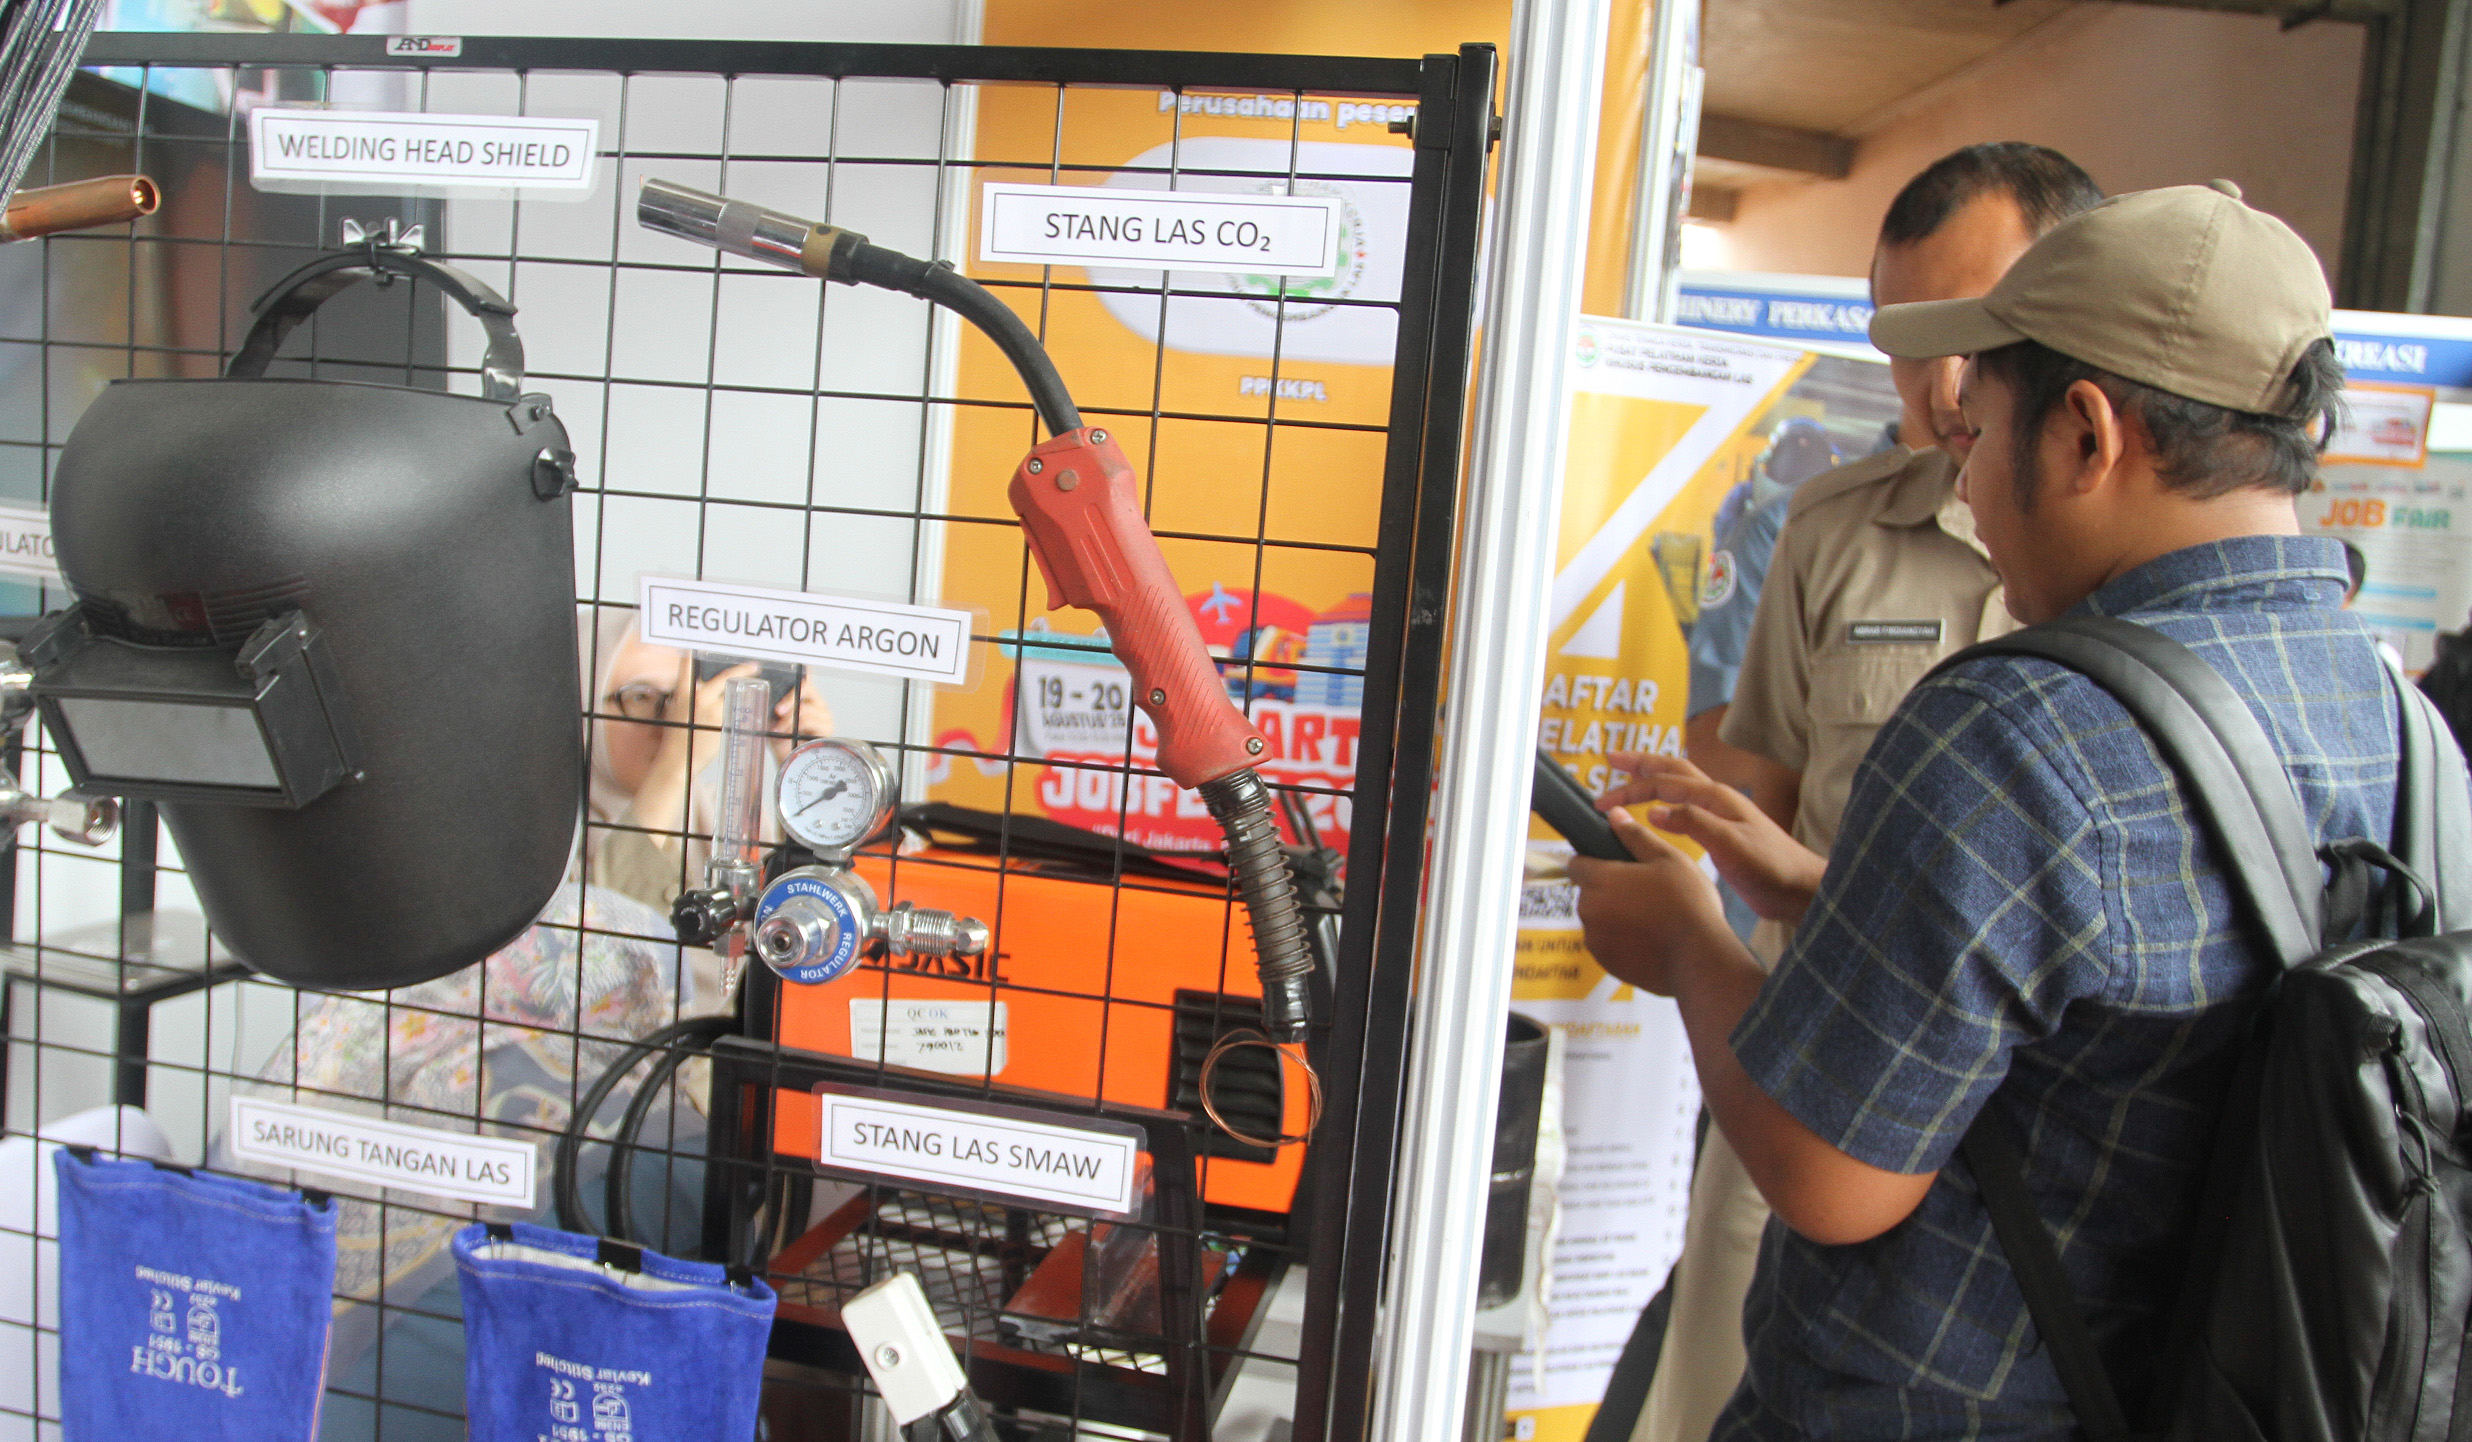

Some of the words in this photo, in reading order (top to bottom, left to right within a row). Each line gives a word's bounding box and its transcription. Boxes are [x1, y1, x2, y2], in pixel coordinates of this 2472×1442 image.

[1158, 91, 1330, 120] Perusahaan
[278, 133, 396, 162] WELDING
[404, 138, 474, 165] HEAD
[481, 142, 571, 167] SHIELD
[1045, 212, 1143, 243] STANG
[1154, 217, 1206, 245] LAS
[2318, 498, 2388, 528] JOB
[668, 603, 828, 646] REGULATOR
[836, 623, 940, 660] ARGON
[1039, 676, 1064, 709] 19
[1091, 682, 1124, 711] 20
[1537, 717, 1688, 759] ELATIHA
[787, 882, 848, 917] STAHLWERK
[800, 932, 852, 980] REGULATOR
[253, 1120, 349, 1158] SARUNG
[357, 1139, 456, 1178] TANGAN
[466, 1159, 509, 1185] LAS
[853, 1122, 942, 1155] STANG
[952, 1135, 999, 1164] LAS
[1008, 1144, 1102, 1181] SMAW
[194, 1278, 242, 1302] Kevlar
[130, 1345, 245, 1399] TOUGH
[535, 1350, 597, 1382] Stitched
[596, 1367, 652, 1387] Kevlar
